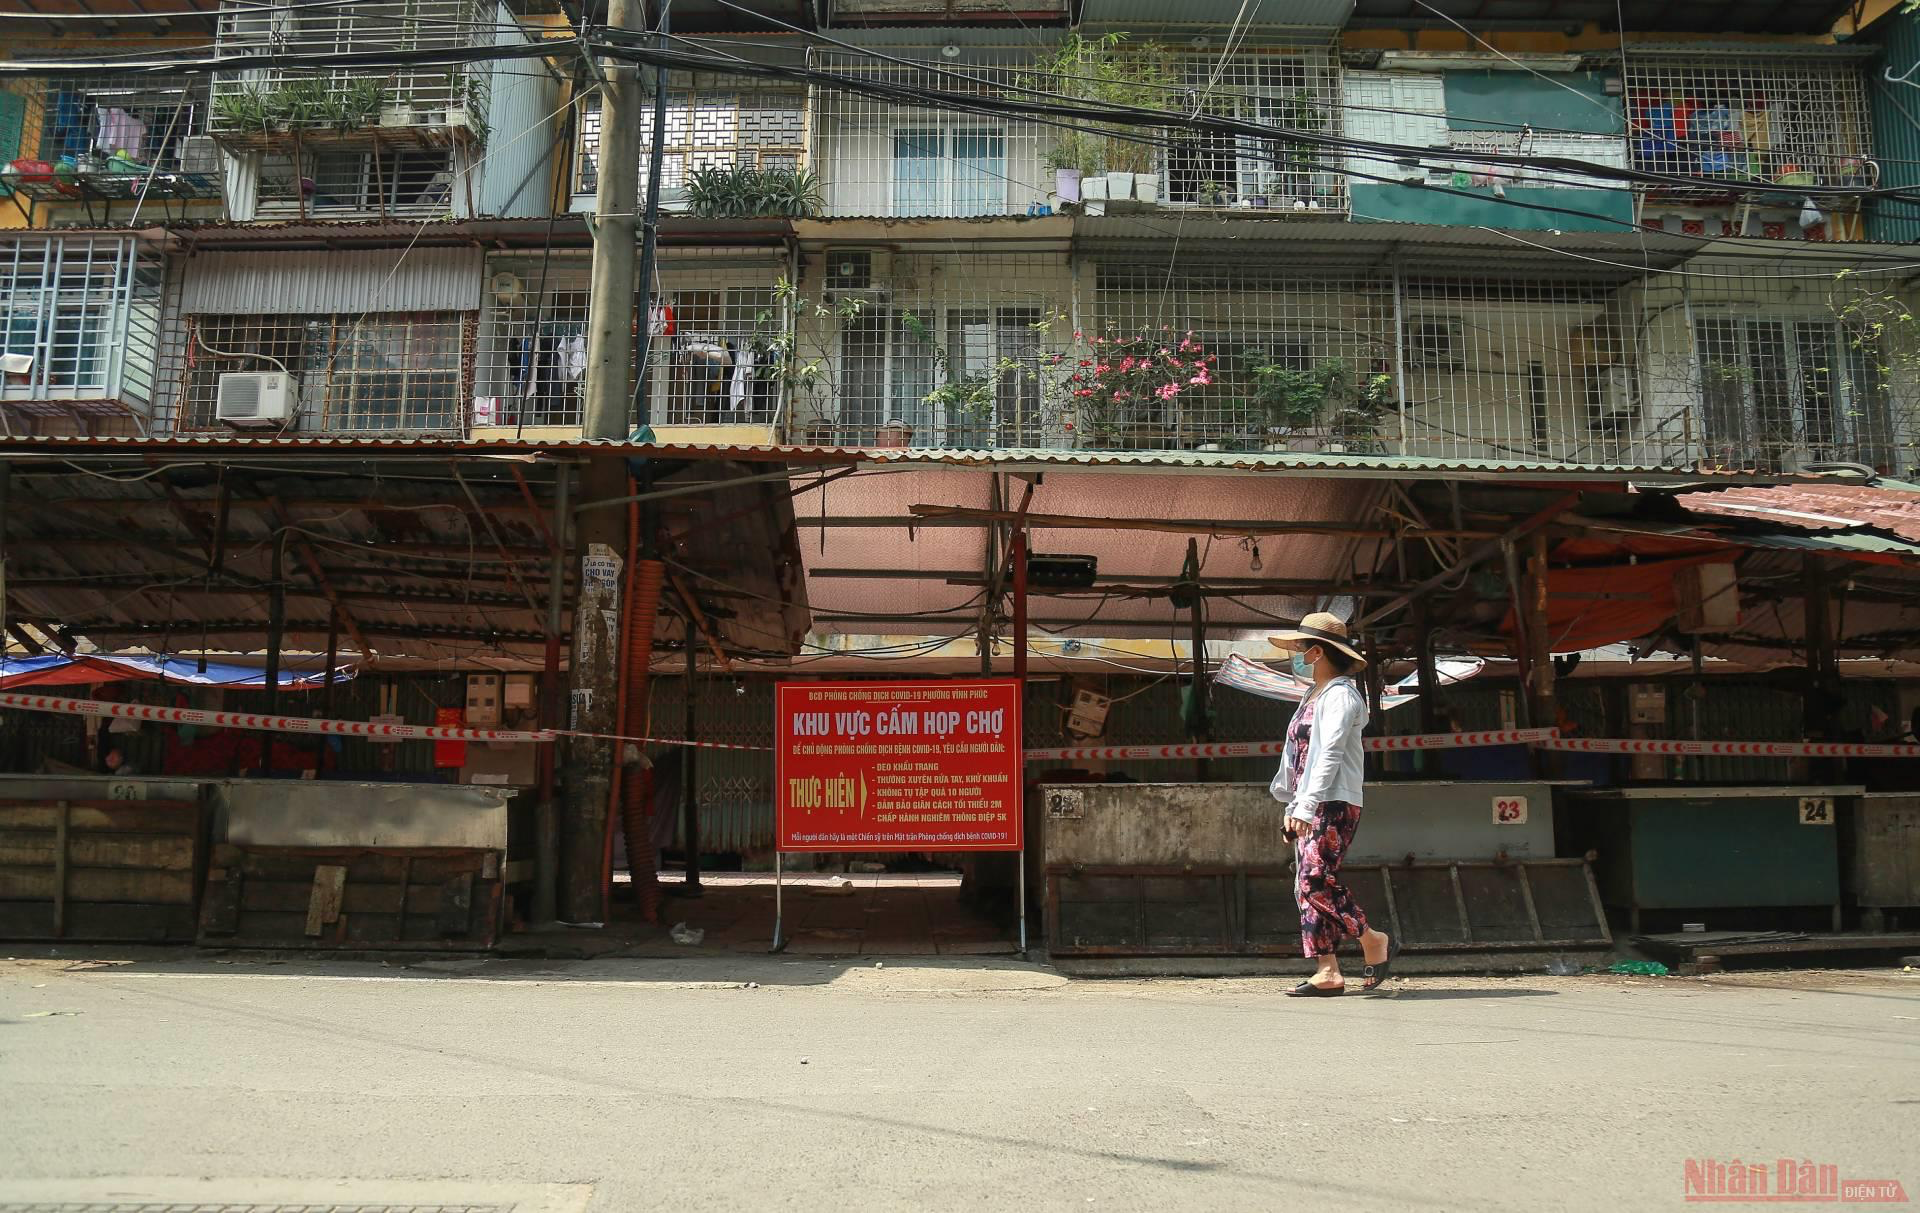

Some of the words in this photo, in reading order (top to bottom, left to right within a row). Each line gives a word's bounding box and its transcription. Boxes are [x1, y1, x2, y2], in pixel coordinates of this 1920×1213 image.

[585, 568, 600, 577] CHO
[602, 569, 615, 577] VAY
[824, 690, 847, 700] PHÒNG
[849, 689, 872, 700] CHỐNG
[874, 691, 889, 702] DỊCH
[891, 691, 921, 700] COVID-19
[923, 688, 950, 700] PHƯỜNG
[970, 688, 988, 699] PHÚC
[793, 712, 830, 736] KHU
[835, 710, 871, 741] VỰC
[876, 703, 918, 735] CẤM
[924, 711, 961, 740] HỌP
[966, 708, 1004, 739] CHỢ
[803, 742, 815, 754] CHỦ
[816, 743, 833, 757] ĐỘNG
[834, 742, 855, 754] PHÒNG
[856, 741, 878, 754] CHỐNG
[879, 744, 893, 756] DỊCH
[895, 743, 911, 756] BỆNH
[912, 744, 942, 755] COVID-19,
[943, 742, 955, 754] YÊU
[956, 741, 969, 753] CẦU
[970, 741, 989, 753] NGƯỜI
[990, 742, 1005, 753] DÂN:
[893, 760, 913, 771] KHẨU
[915, 762, 939, 771] TRANG
[877, 774, 906, 784] THƯỜNG
[908, 774, 932, 784] XUYÊN
[934, 773, 949, 783] RỬA
[951, 775, 964, 784] TAY,
[966, 772, 982, 783] KHỬ
[983, 771, 1009, 783] KHUẨN
[789, 775, 822, 815] THỰC
[825, 771, 855, 815] HIỆN
[877, 787, 903, 797] KHÔNG
[904, 788, 913, 799] TỤ
[915, 787, 929, 799] TẬP
[931, 787, 946, 797] QUÁ
[948, 788, 957, 797] 10
[959, 786, 982, 797] NGƯỜI
[877, 799, 894, 810] ĐẢM
[896, 799, 911, 810] BẢO
[932, 799, 952, 809] CÁCH
[954, 798, 966, 809] TỐI
[968, 797, 989, 809] THIỂU
[990, 800, 1002, 809] 2M
[878, 811, 897, 822] CHẤP
[898, 812, 919, 822] HÀNH
[922, 812, 950, 822] NGHIÊM
[952, 812, 977, 822] THÔNG
[978, 811, 995, 823] ĐIỆP
[997, 813, 1007, 821] 5K
[1497, 800, 1520, 821] 23
[1804, 800, 1828, 821] 24
[858, 832, 874, 841] Chiến
[919, 832, 936, 843] Phòng
[936, 832, 953, 842] chống
[954, 832, 966, 842] dịch
[966, 832, 981, 842] bệnh
